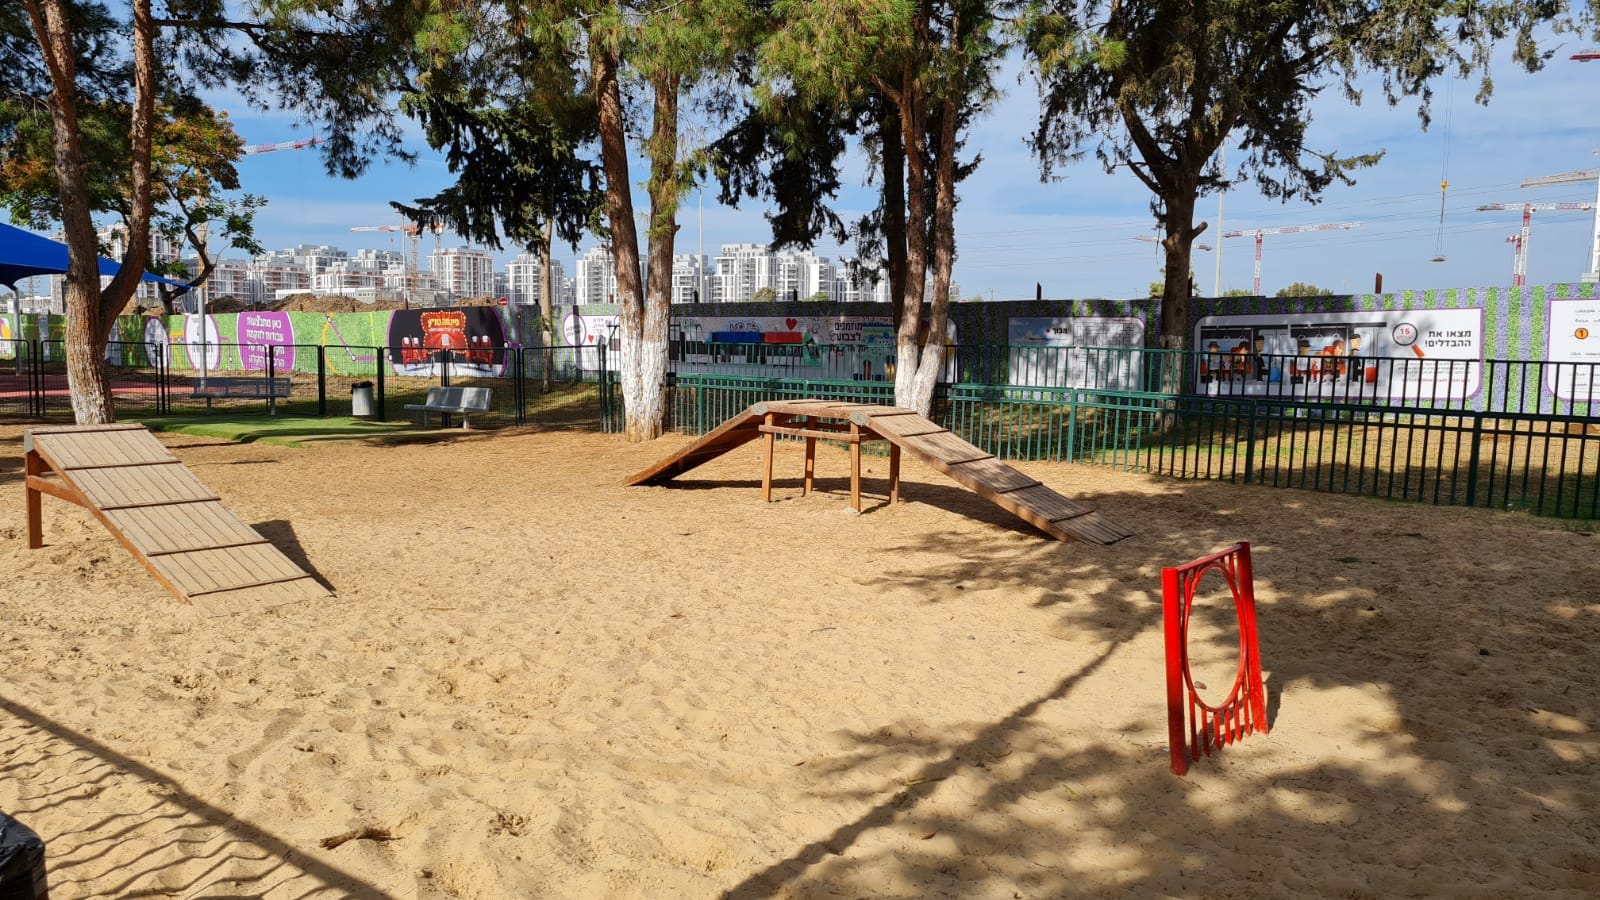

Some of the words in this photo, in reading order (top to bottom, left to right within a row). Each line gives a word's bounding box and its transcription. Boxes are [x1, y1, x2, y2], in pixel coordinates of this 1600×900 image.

[834, 322, 863, 331] מוזמנים
[1052, 327, 1068, 335] מבוך
[1428, 330, 1443, 338] את
[1446, 330, 1472, 338] מצאו
[836, 332, 862, 341] לצבוע
[1425, 339, 1472, 348] ההבדלים!
